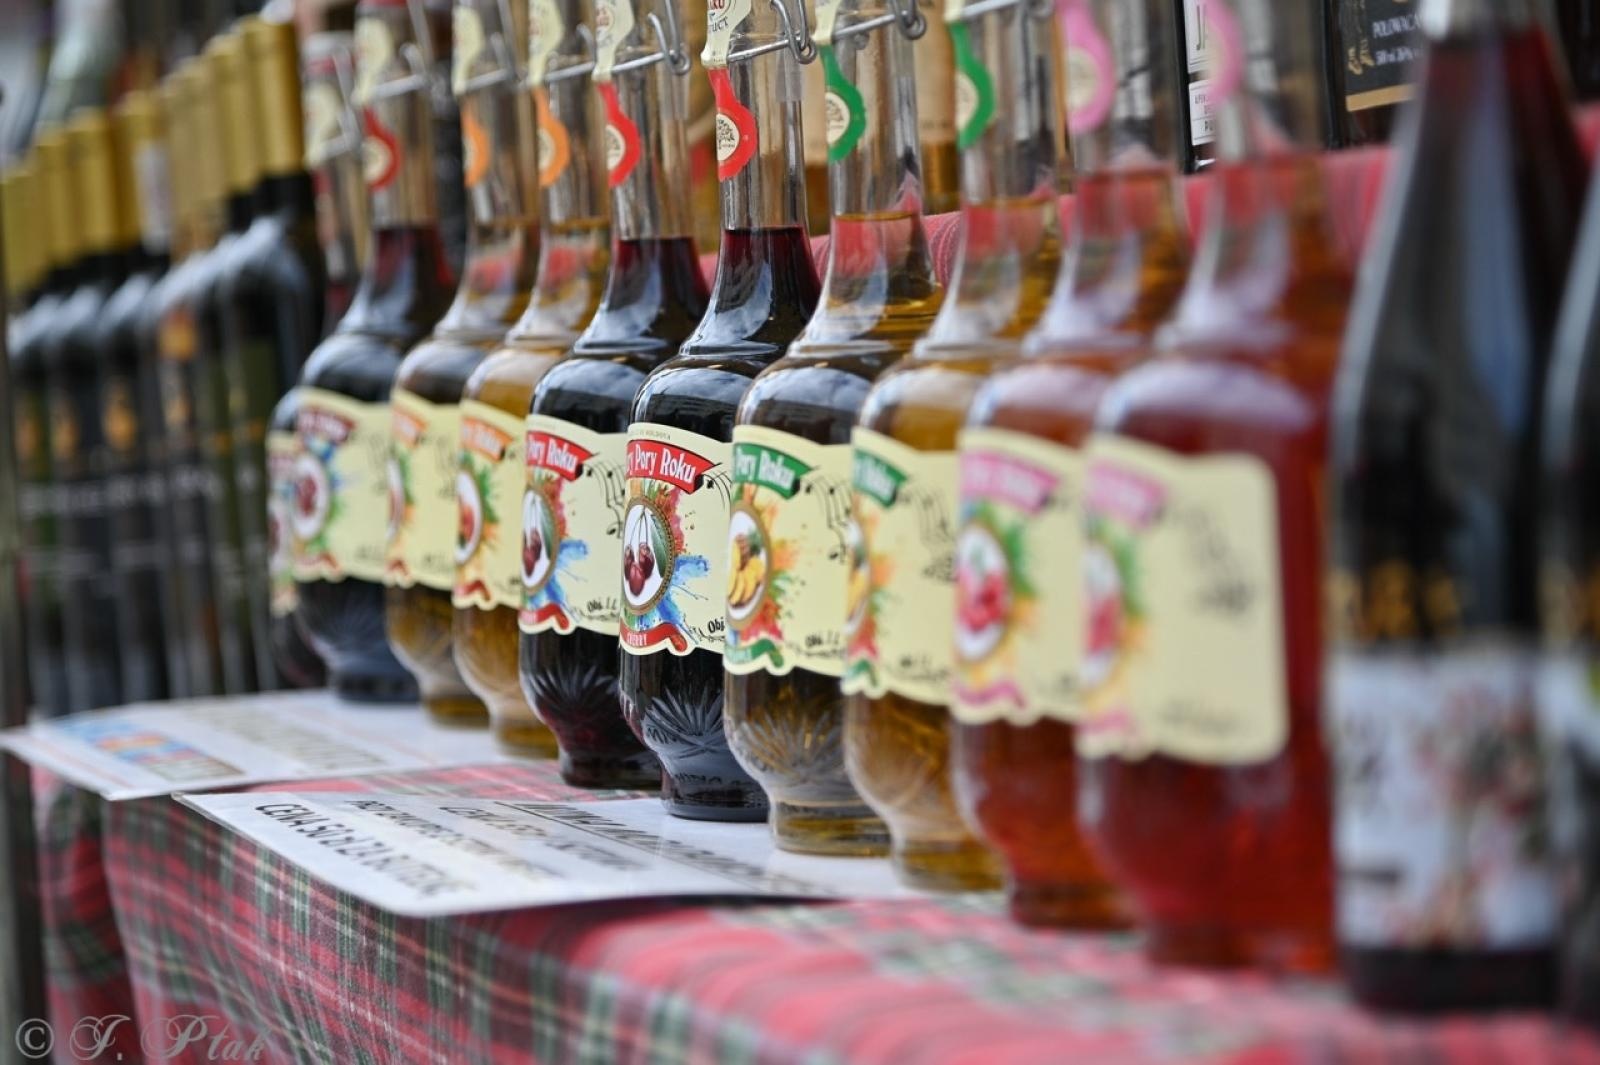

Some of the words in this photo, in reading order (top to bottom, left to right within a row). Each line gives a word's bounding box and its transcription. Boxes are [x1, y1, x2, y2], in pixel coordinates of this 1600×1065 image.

[546, 436, 579, 473] Roku
[634, 443, 657, 476] Pory
[660, 447, 696, 484] Roku
[759, 449, 796, 490] Roku
[253, 802, 331, 827] CENA
